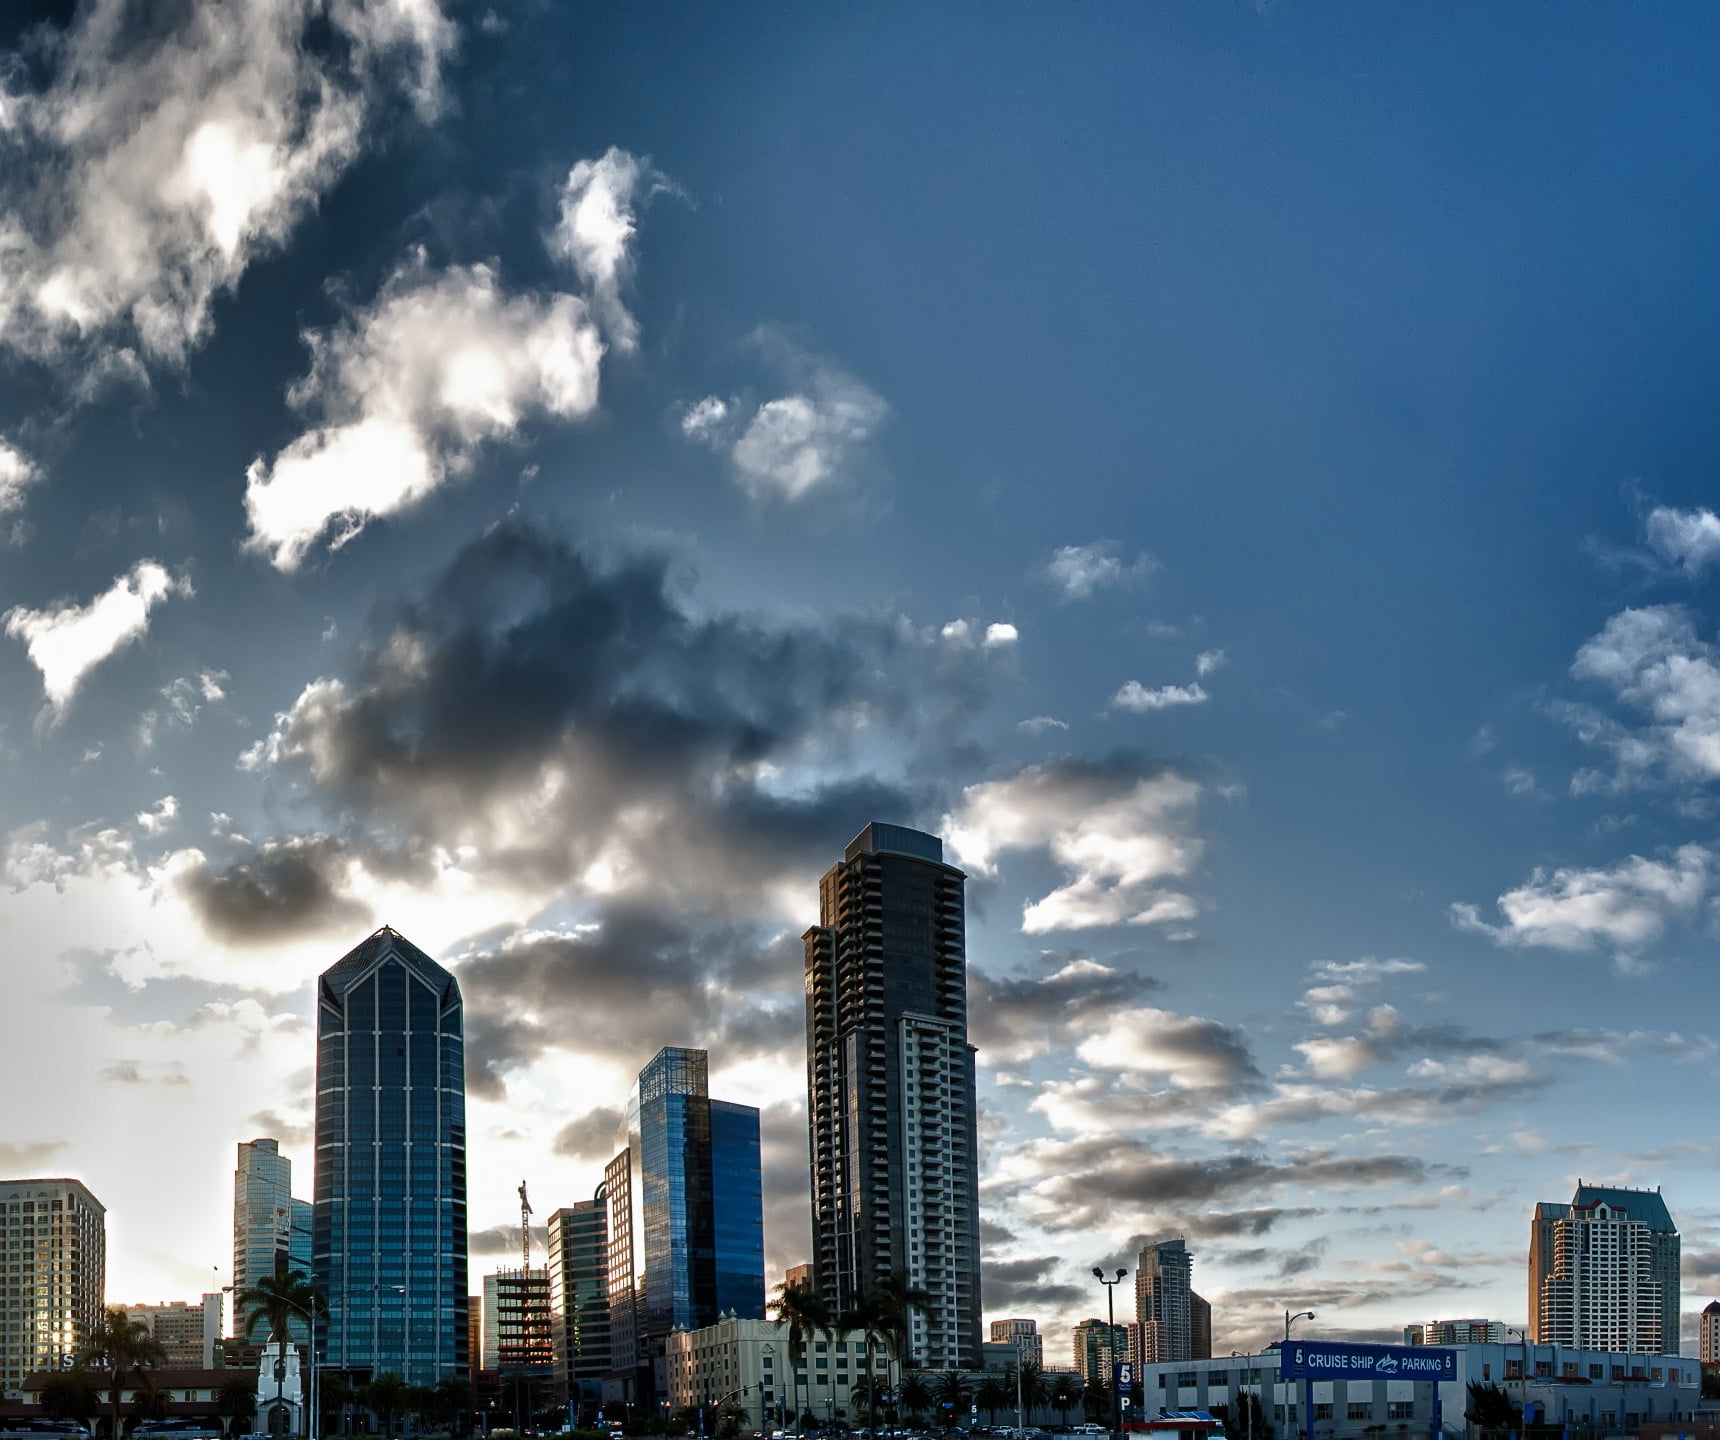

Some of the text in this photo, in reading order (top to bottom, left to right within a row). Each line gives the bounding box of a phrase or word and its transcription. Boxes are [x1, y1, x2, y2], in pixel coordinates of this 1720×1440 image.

[1295, 1348, 1303, 1364] 5
[1308, 1354, 1348, 1368] CRUISE
[1351, 1356, 1374, 1369] SHIP
[1401, 1357, 1442, 1371] PARKING
[1445, 1355, 1451, 1369] 5
[1120, 1364, 1131, 1383] 5
[1120, 1397, 1131, 1411] P
